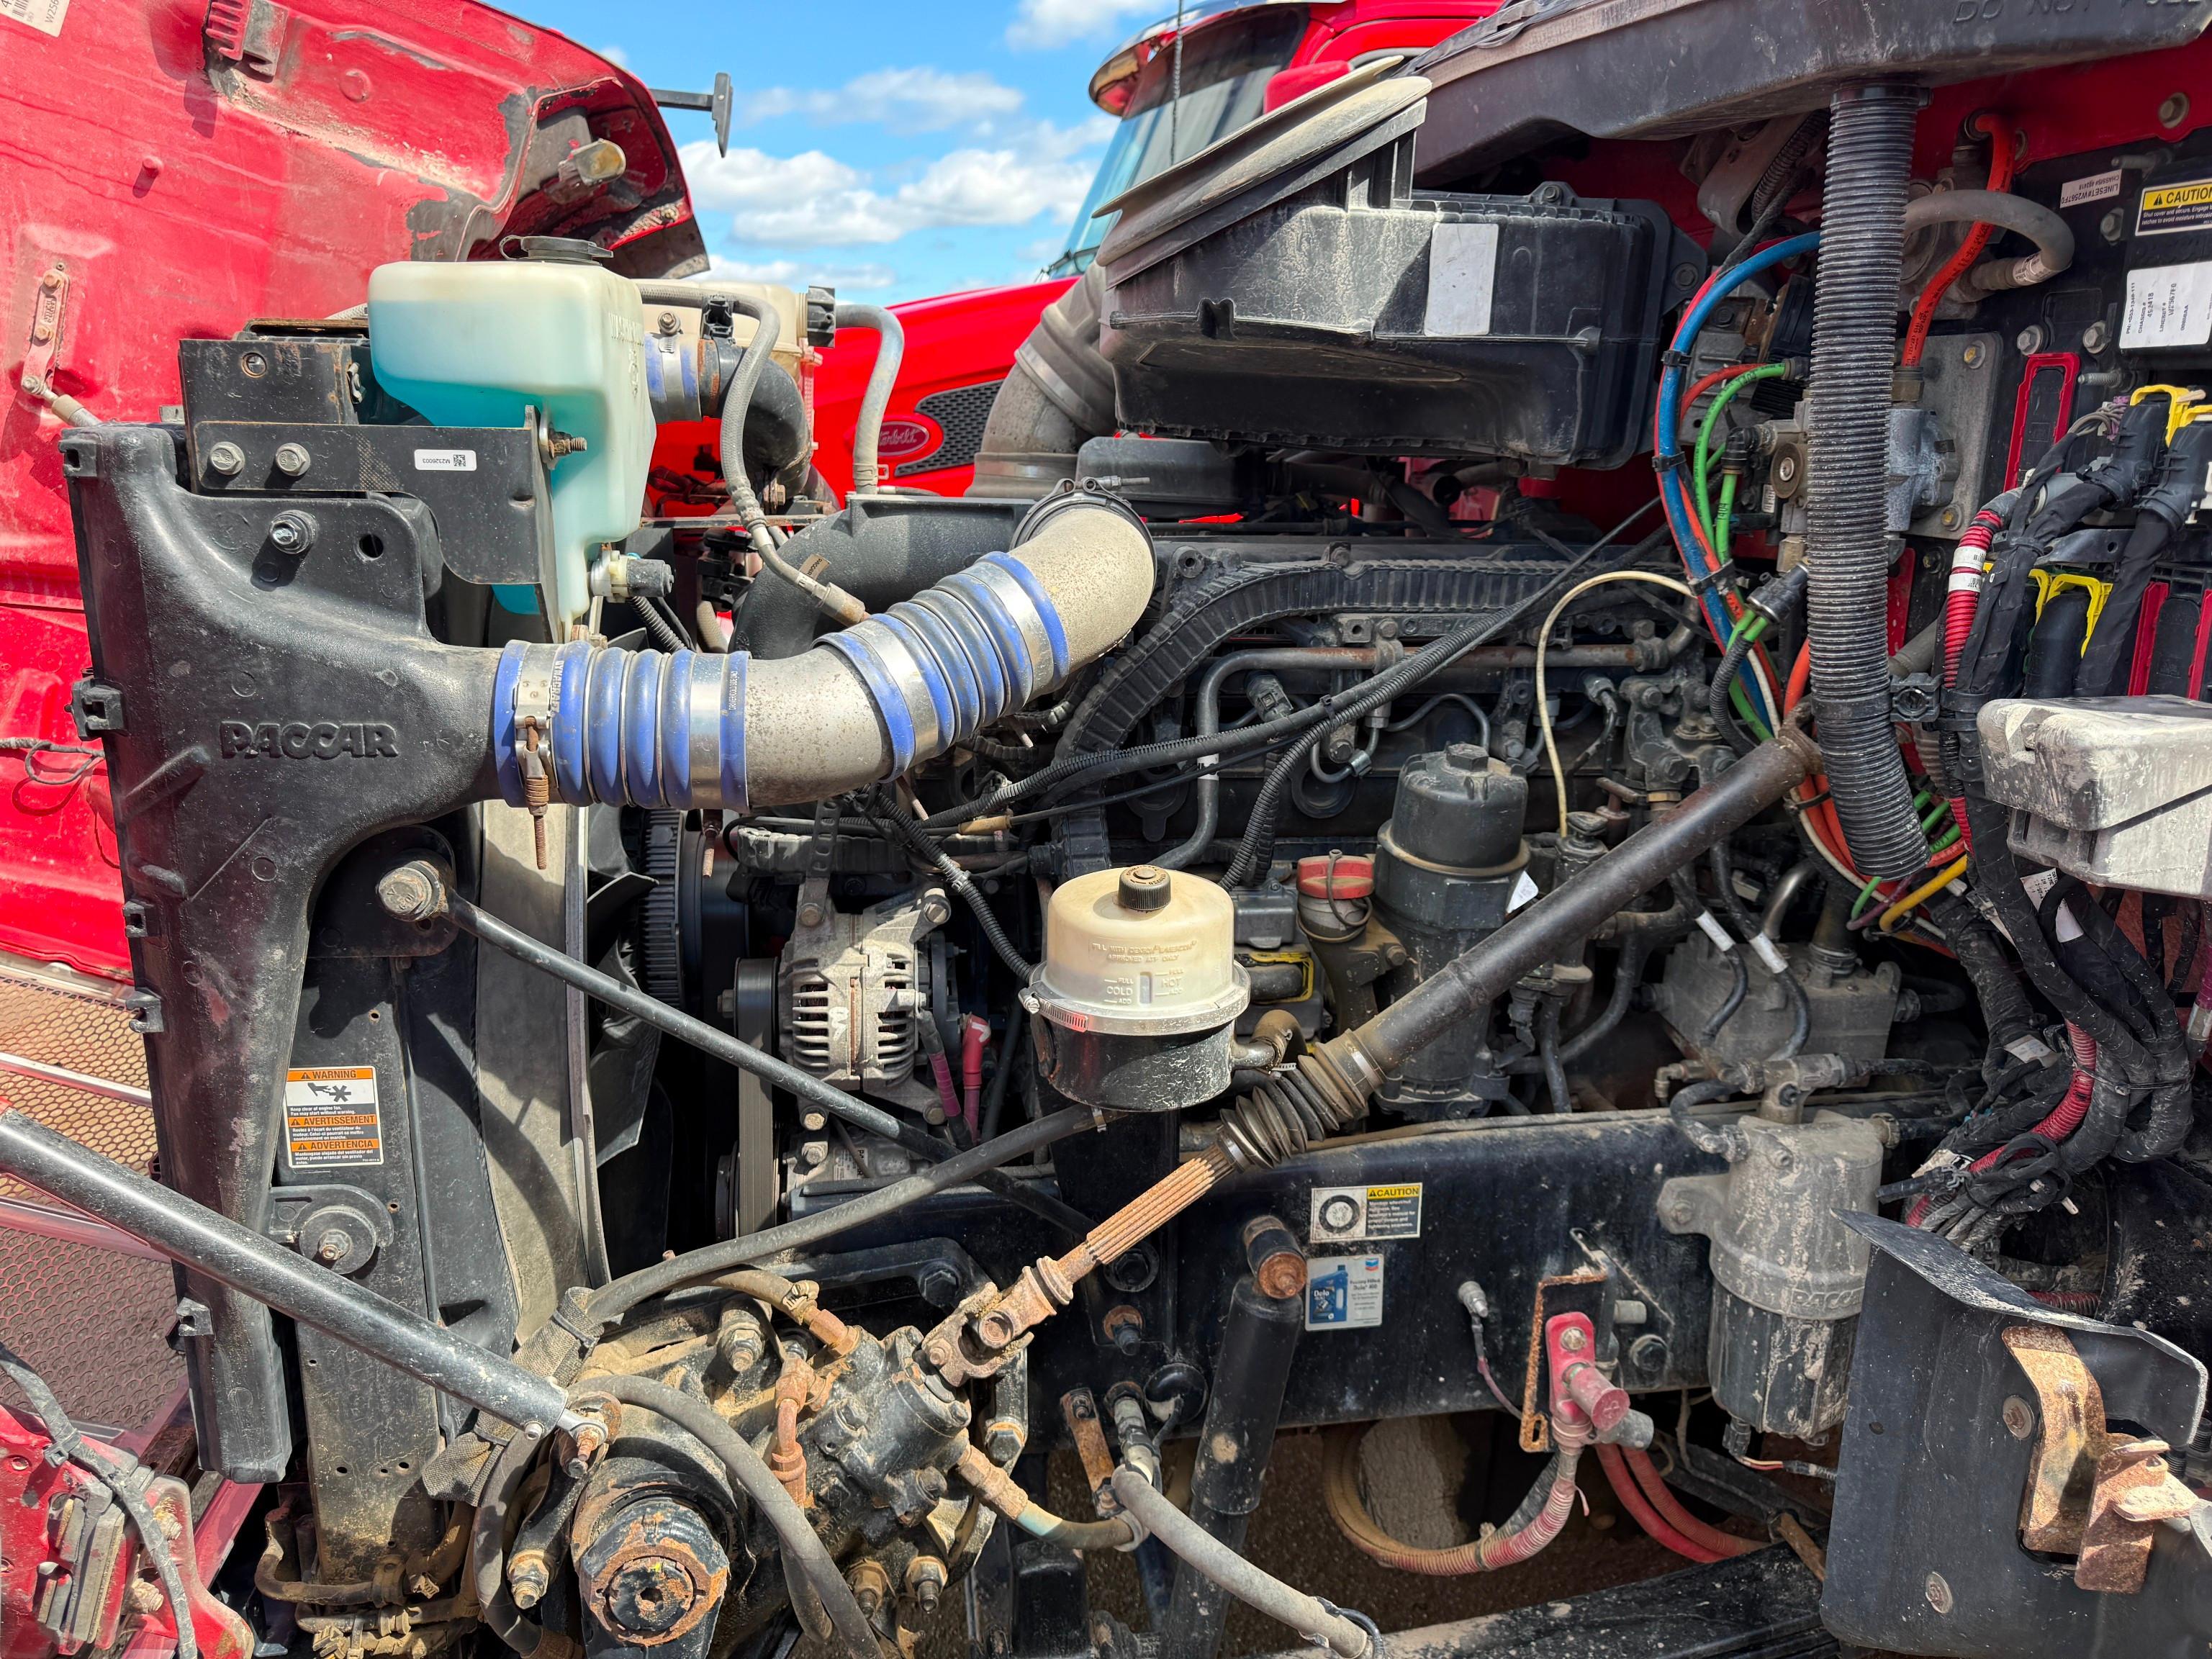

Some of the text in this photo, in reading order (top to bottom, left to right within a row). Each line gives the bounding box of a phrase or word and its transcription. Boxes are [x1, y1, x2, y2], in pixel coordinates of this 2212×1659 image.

[551, 660, 565, 713] DYNACRAFT
[219, 720, 399, 760] PACCAR
[1117, 977, 1134, 985] FULL
[1161, 977, 1182, 988] HOT
[1106, 986, 1133, 995] COLD
[312, 1070, 356, 1080] WARNING
[303, 1116, 375, 1126] AVERTISSEMENT
[310, 1140, 374, 1150] ADVERTENCIA
[1377, 1187, 1419, 1197] CAUTION
